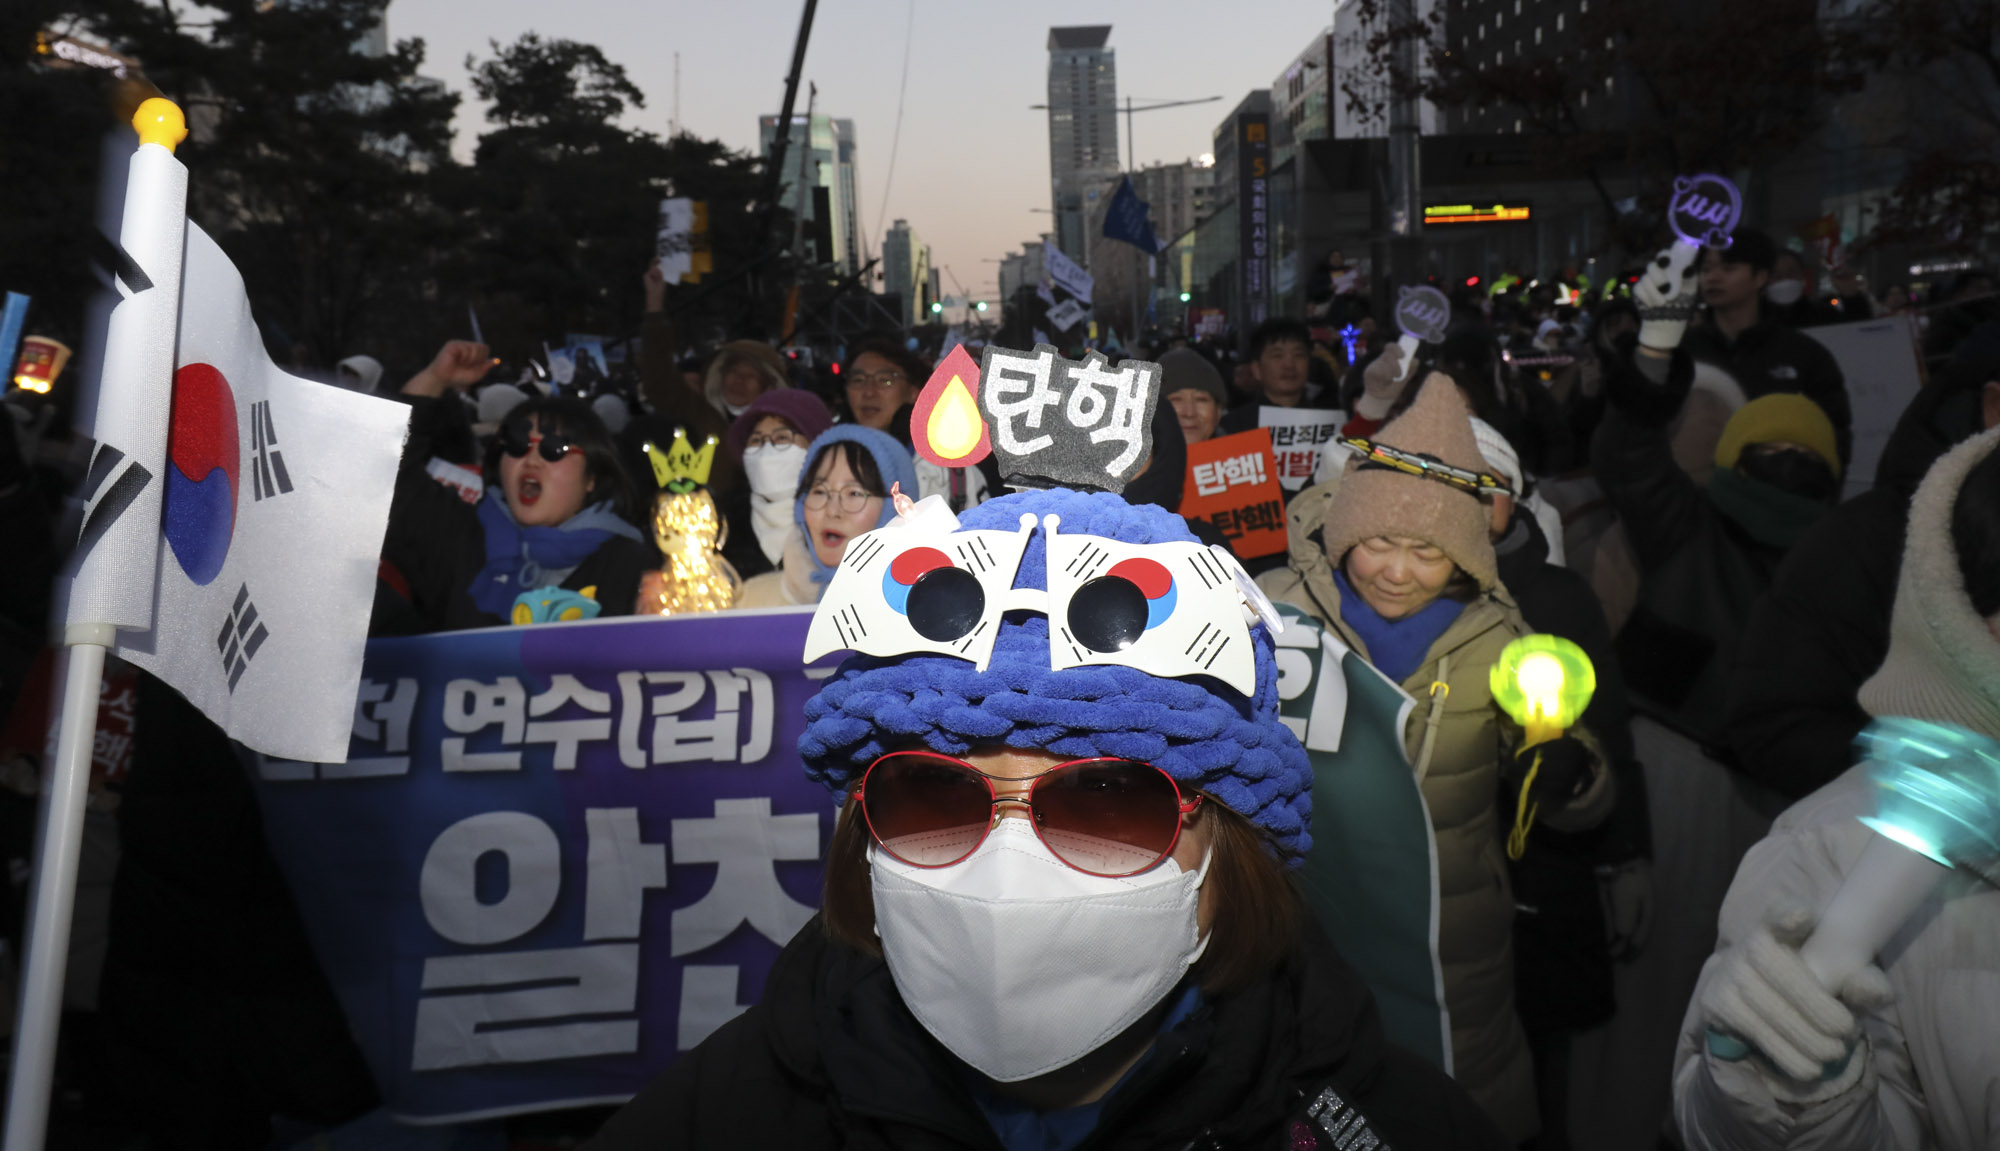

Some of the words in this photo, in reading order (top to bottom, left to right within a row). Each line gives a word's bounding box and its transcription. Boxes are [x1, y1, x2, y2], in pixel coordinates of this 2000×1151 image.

[985, 351, 1151, 478] 탄핵
[1270, 424, 1335, 446] 란죄로
[1193, 452, 1267, 497] 탄핵!
[1211, 500, 1284, 540] 탄핵!
[441, 667, 775, 773] 연수(갑)
